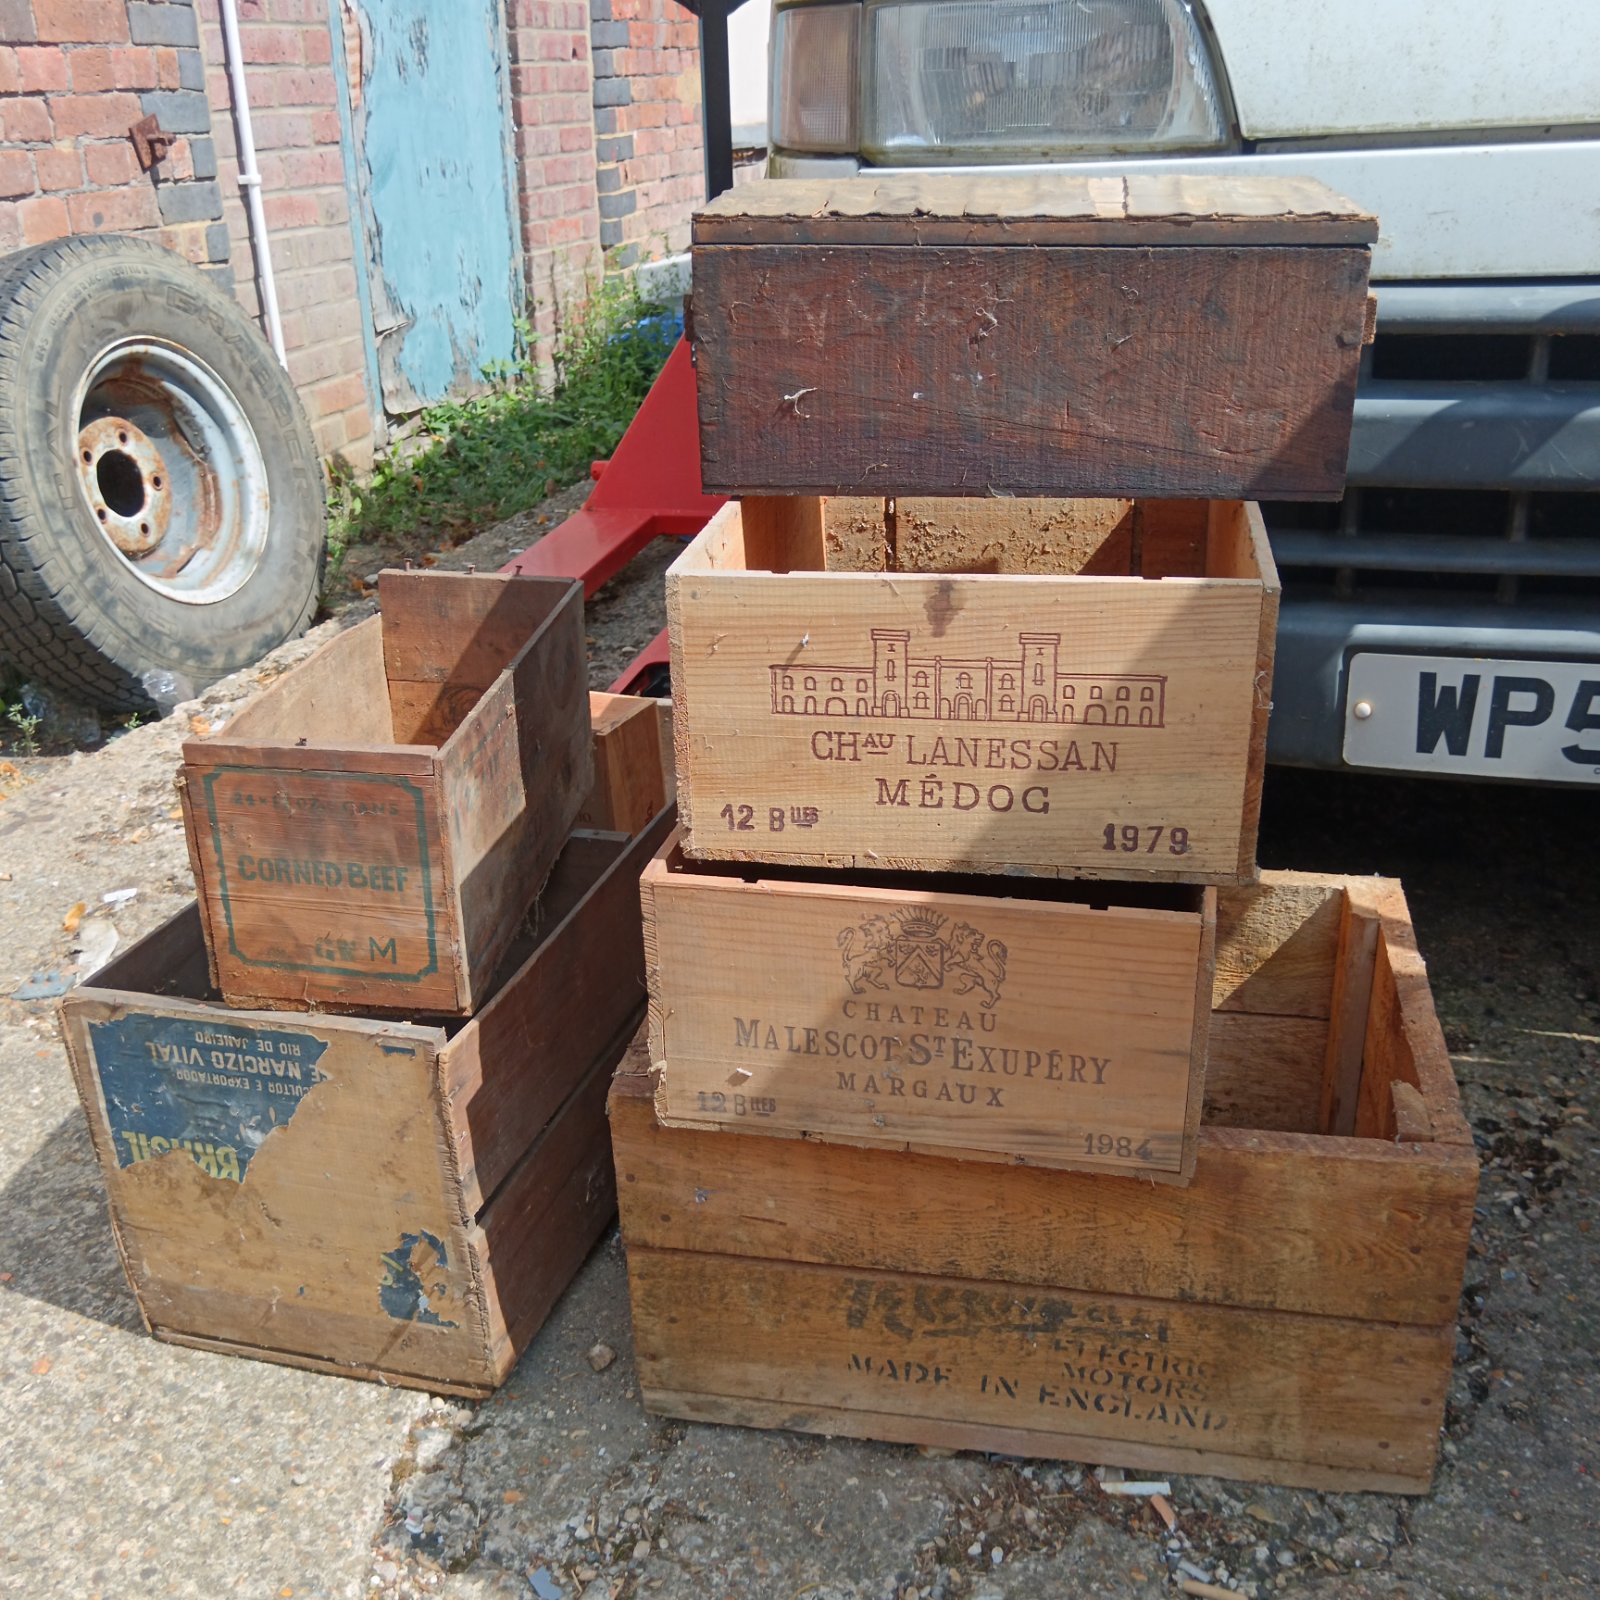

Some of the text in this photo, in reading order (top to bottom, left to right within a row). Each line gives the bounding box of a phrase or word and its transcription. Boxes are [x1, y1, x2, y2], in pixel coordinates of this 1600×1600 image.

[906, 734, 1118, 773] LANESSAN
[875, 773, 1049, 815] MÉDOC
[720, 803, 755, 831] 12
[1102, 822, 1190, 855] 1979
[237, 854, 409, 893] CORNED BEEF
[843, 1000, 998, 1032] CHATEAU
[145, 1041, 204, 1067] VITAL
[195, 1031, 301, 1056] RIO DE JANEIRO
[734, 1017, 901, 1062] MALESCOT
[951, 1038, 1112, 1084] EXUPÉRY
[176, 1068, 250, 1089] EXPORTADOR
[210, 1051, 301, 1081] NARCIZO
[255, 1079, 263, 1091] E
[837, 1071, 1004, 1108] MARGAUX
[697, 1091, 727, 1113] 12
[1083, 1131, 1154, 1162] 1984
[847, 1353, 1228, 1430] MADE IN ENGLAND
[1062, 1361, 1208, 1400] MOTORS
